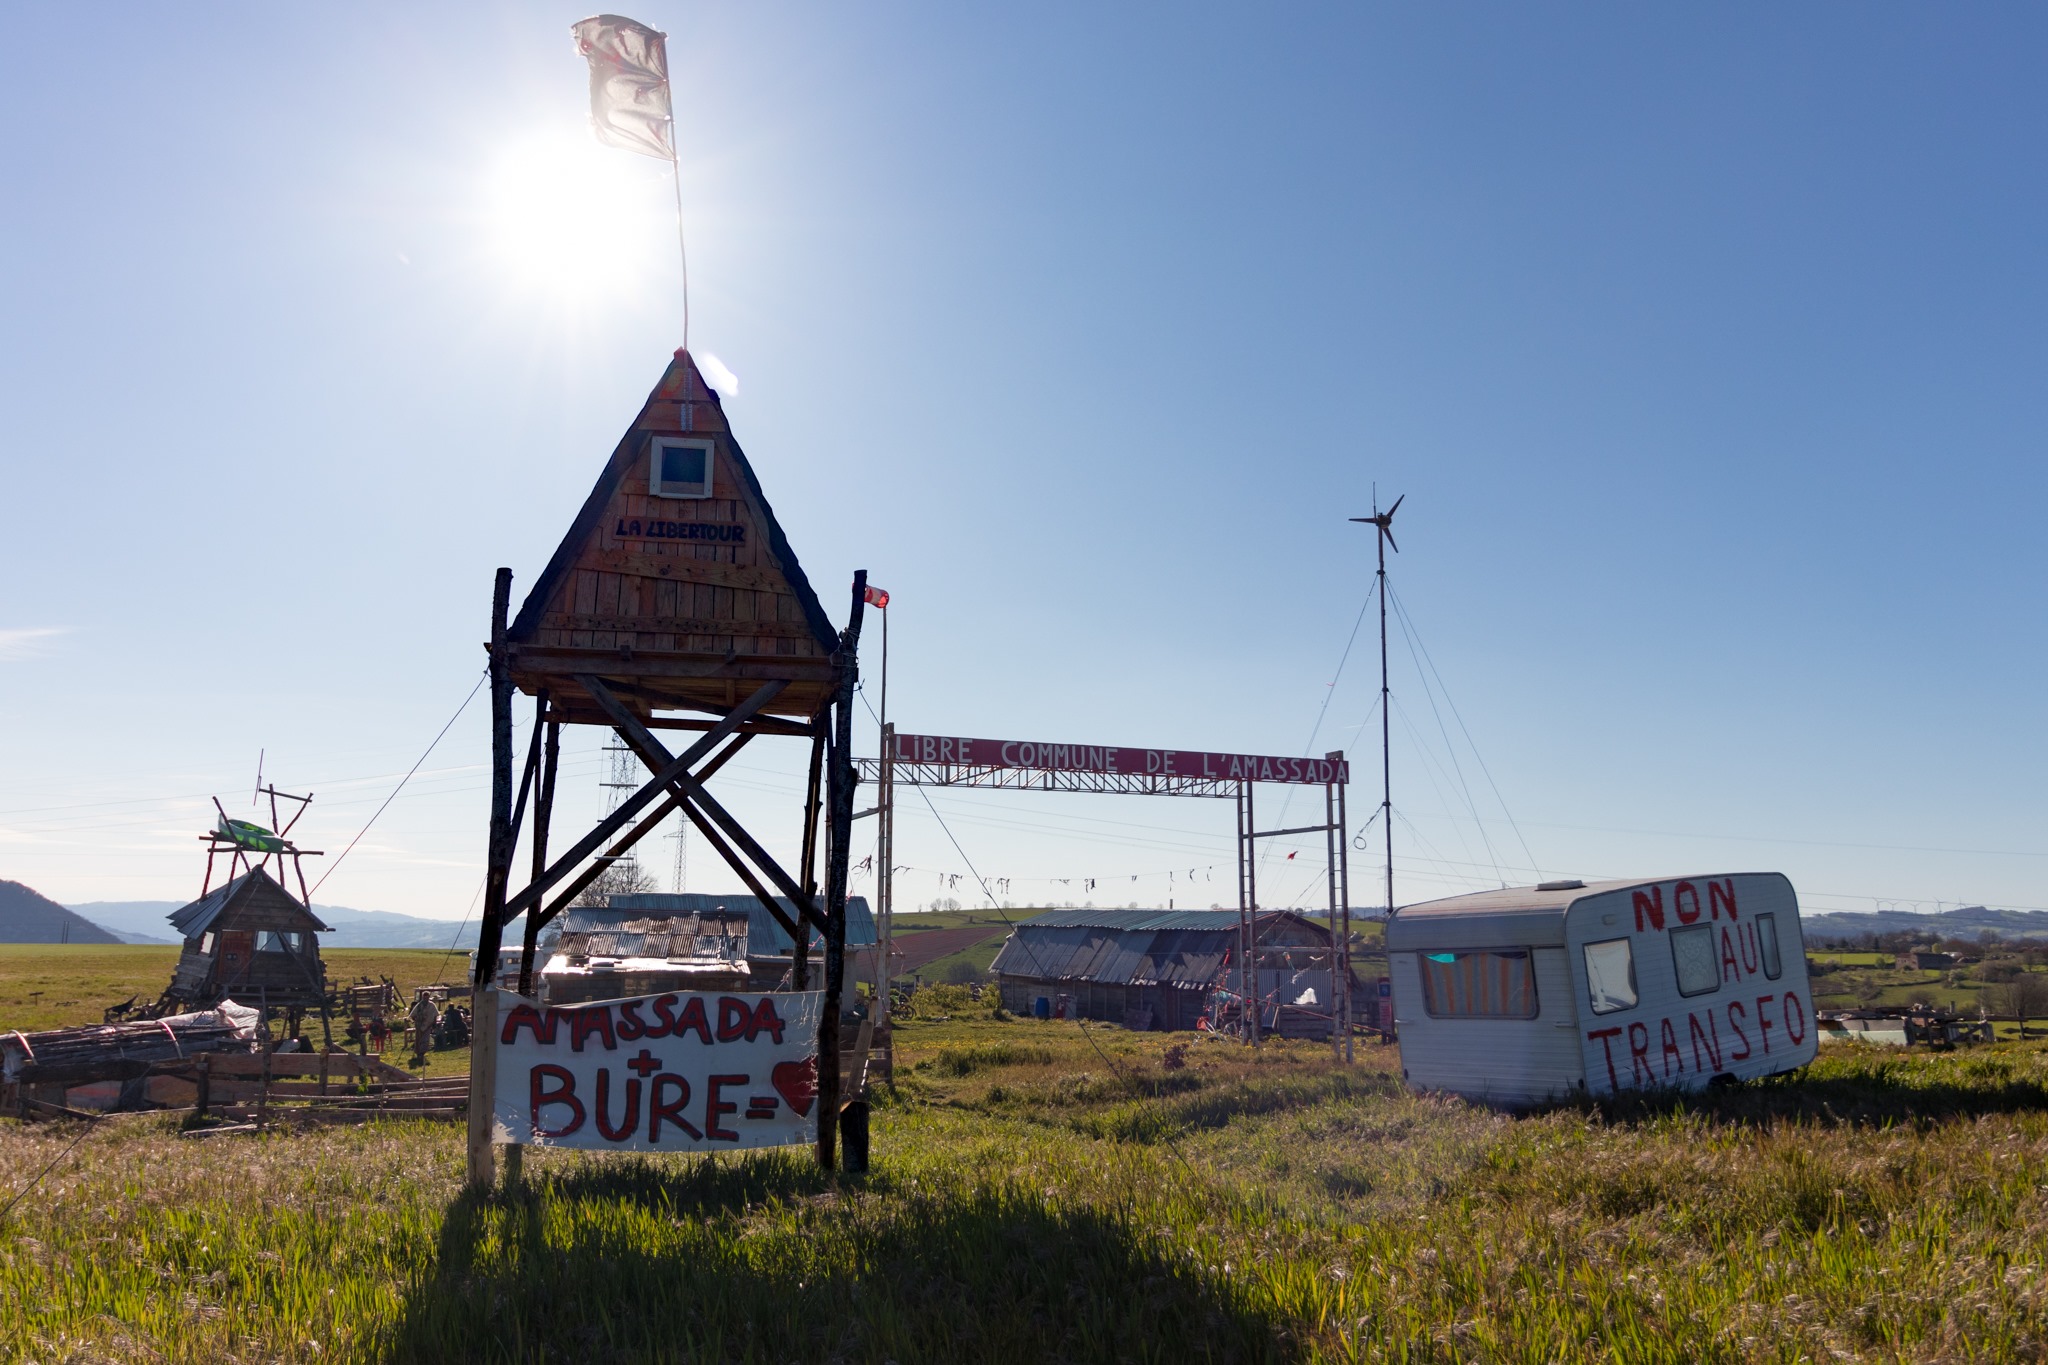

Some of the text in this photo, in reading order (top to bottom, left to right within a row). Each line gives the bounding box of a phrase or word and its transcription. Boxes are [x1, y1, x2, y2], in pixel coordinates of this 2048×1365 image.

[616, 519, 746, 543] LA LIBERTOUR
[1001, 741, 1118, 770] COMMUNE
[1146, 750, 1176, 774] DE
[1203, 753, 1347, 783] L'AMASSADA
[1631, 878, 1739, 932] NON
[1720, 922, 1758, 983] AU
[501, 994, 786, 1052] AMASSADA
[1587, 991, 1805, 1092] TRANSFO
